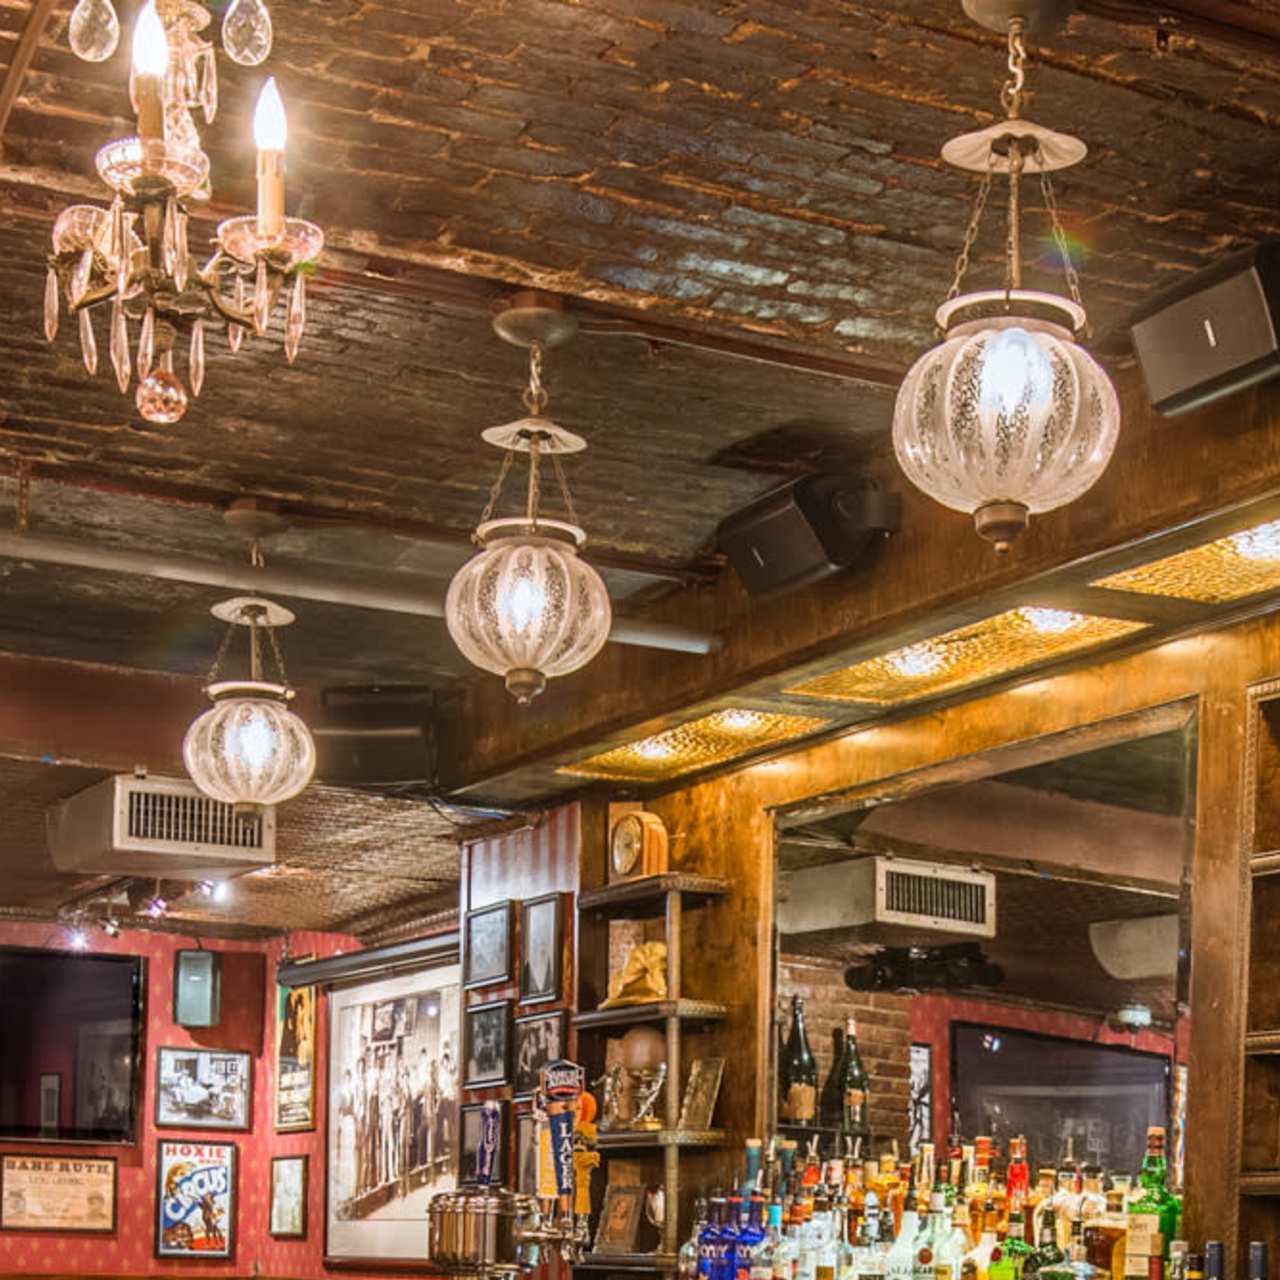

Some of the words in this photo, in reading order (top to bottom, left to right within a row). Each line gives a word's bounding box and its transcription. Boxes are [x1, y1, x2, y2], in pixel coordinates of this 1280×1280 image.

[5, 1160, 54, 1172] BABE
[165, 1146, 225, 1159] HOXIE
[558, 1122, 573, 1189] LAGER
[164, 1167, 228, 1221] CIRCUS
